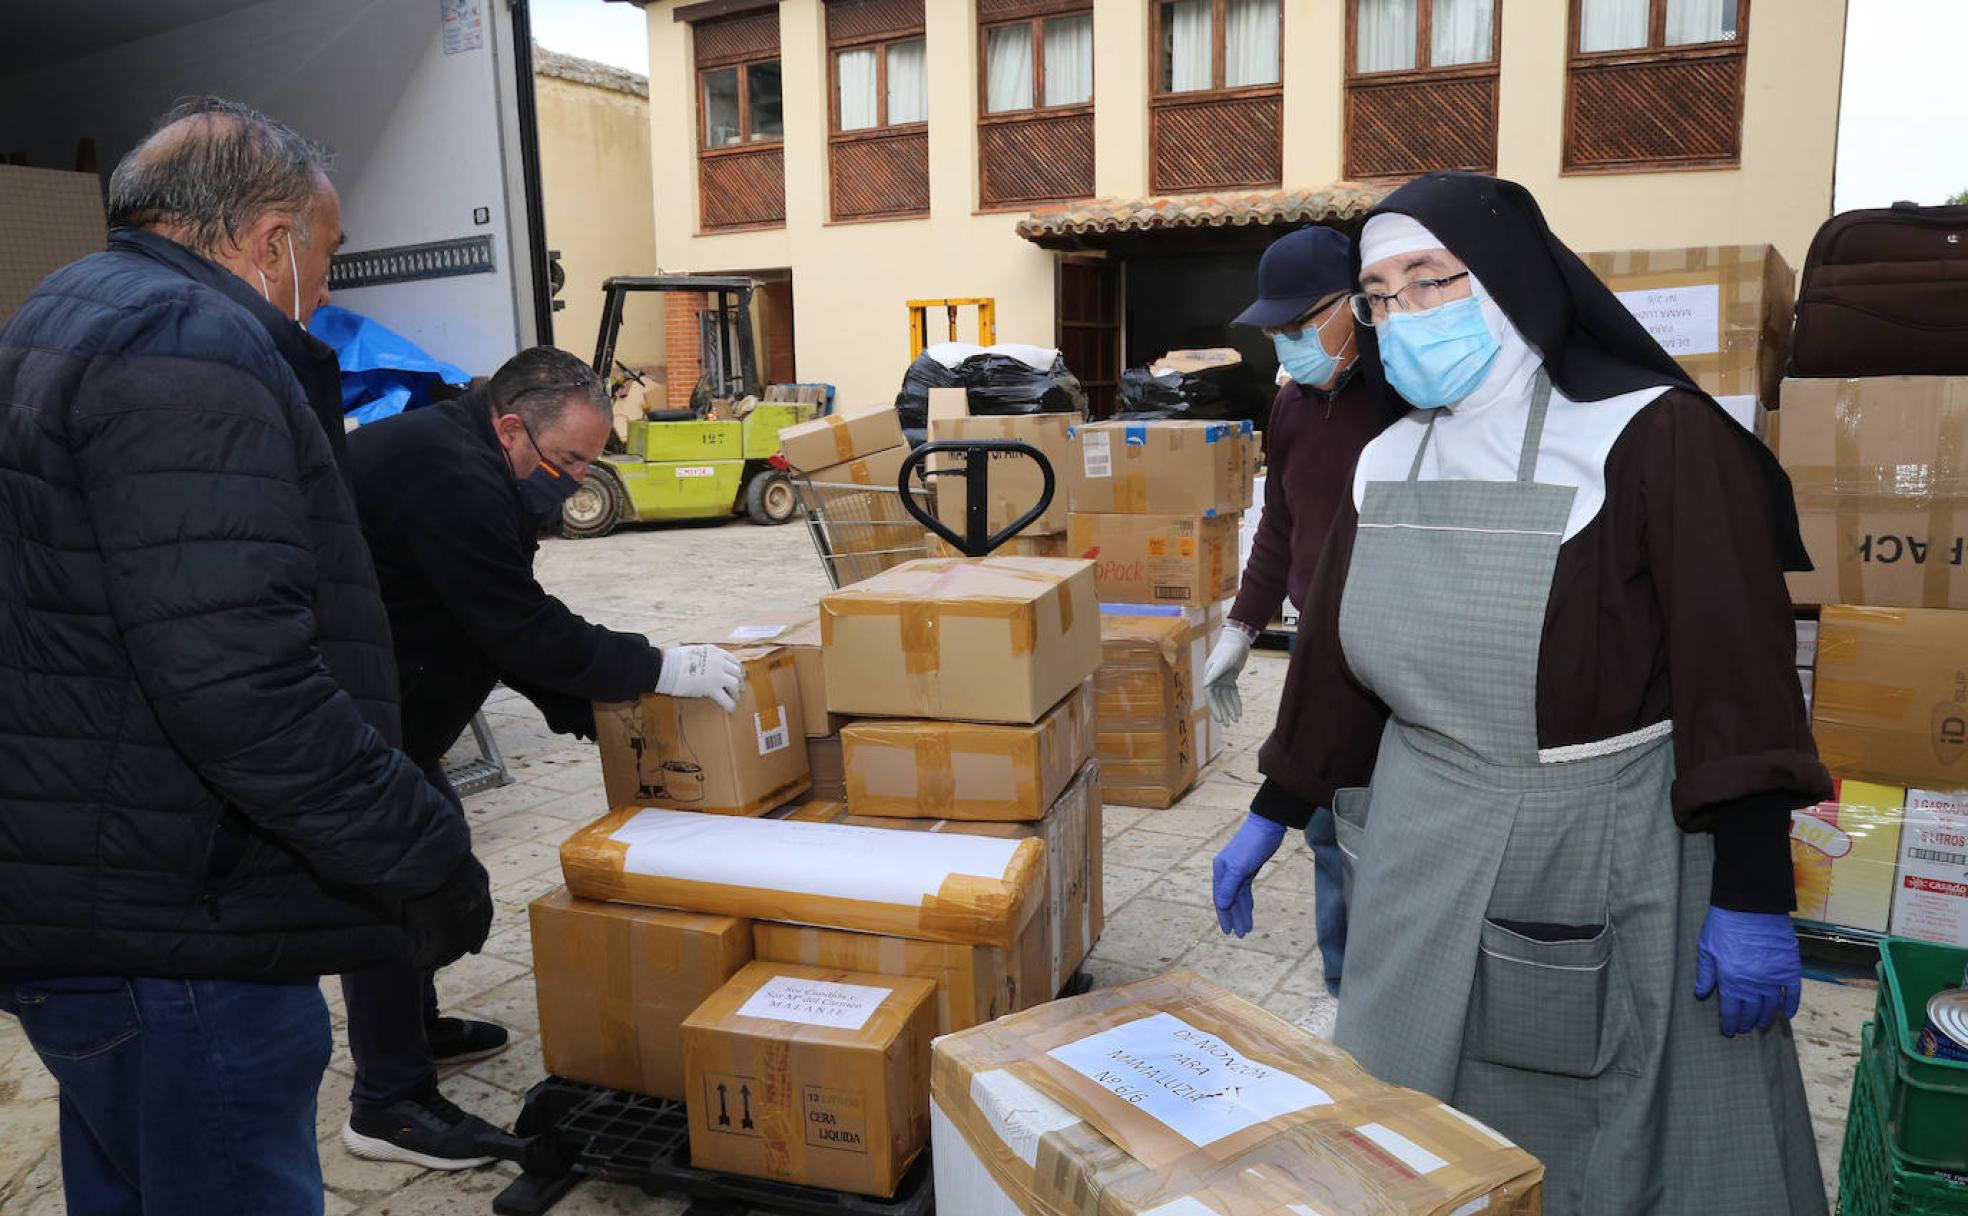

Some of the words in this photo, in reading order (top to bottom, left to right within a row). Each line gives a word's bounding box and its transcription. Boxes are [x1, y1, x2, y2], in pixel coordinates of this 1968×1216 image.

[1169, 1052, 1212, 1077] PARA
[1114, 1082, 1149, 1105] 6/6
[810, 1110, 837, 1125] CERA
[819, 1127, 861, 1145] LIQUIDA
